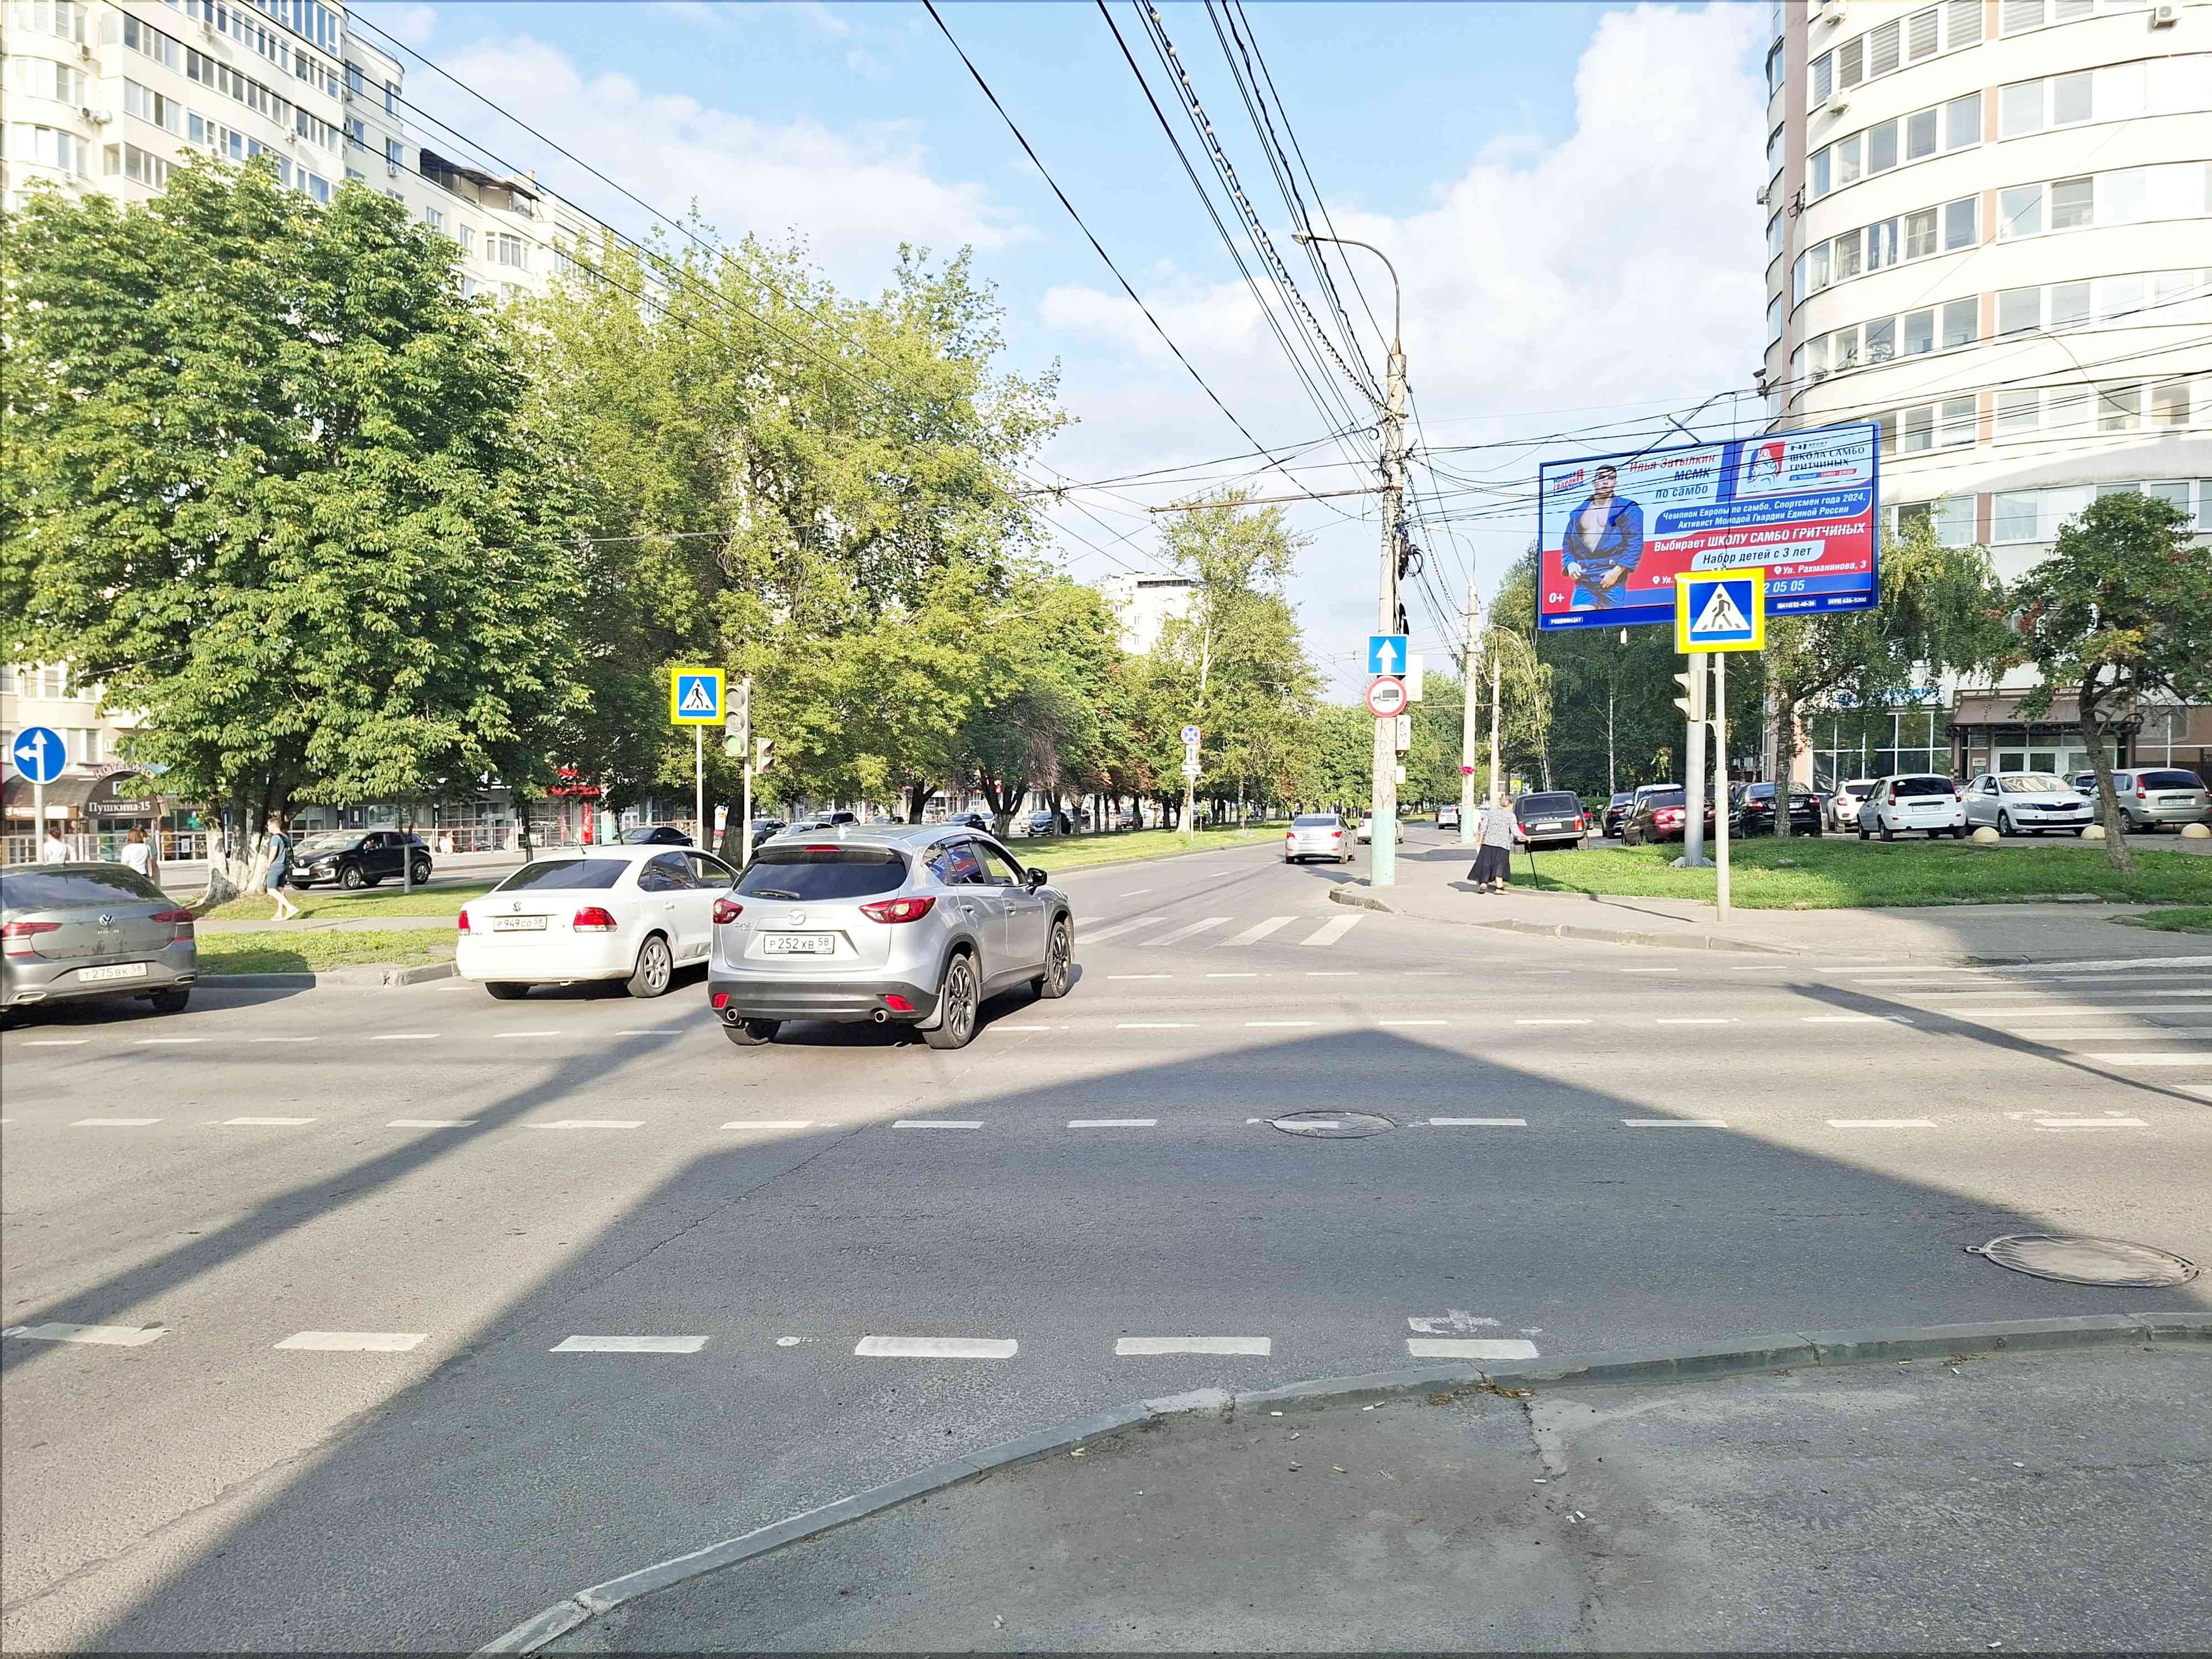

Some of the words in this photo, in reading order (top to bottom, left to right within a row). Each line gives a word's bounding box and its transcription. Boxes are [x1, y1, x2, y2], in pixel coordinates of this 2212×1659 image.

[1790, 451, 1826, 461] ШКОЛА
[1830, 446, 1865, 457] САМБО
[1629, 461, 1657, 472] Илья
[1790, 459, 1849, 471] ГРИТЧИНЫХ
[1656, 490, 1669, 499] по
[1672, 484, 1709, 497] самбо
[1664, 510, 1698, 520] Чемпион
[1699, 507, 1729, 517] Европы
[1743, 501, 1771, 513] самбо,
[1774, 498, 1820, 510] Спортсмен
[1821, 496, 1840, 505] года
[1843, 493, 1866, 503] 2024,
[1677, 519, 1713, 529] Активист
[1715, 514, 1751, 525] Молодой
[1752, 512, 1785, 523] Гвардии
[1787, 507, 1817, 519] Единой
[1819, 506, 1849, 515] России
[1654, 539, 1706, 552] Выбирает
[1707, 533, 1748, 547] ШКОЛУ
[1750, 529, 1790, 543] САМБО
[1792, 522, 1866, 540] ГРИТЧИНЫХ
[1703, 552, 1736, 565] Набор
[1739, 548, 1770, 563] детей
[1774, 550, 1779, 558] с
[1783, 547, 1789, 558] 3
[1793, 547, 1812, 557] лет
[1783, 566, 1795, 575] Ул.
[1798, 562, 1858, 574] Рахманинова,
[1860, 559, 1867, 569] 3
[1662, 575, 1673, 585] Ул.
[1772, 581, 1787, 593] 05
[1790, 579, 1805, 592] 05
[1549, 592, 1565, 604] 0+
[770, 938, 814, 949] Р252ХВ
[818, 938, 829, 946] 58
[84, 967, 128, 979] Т275ВК
[131, 964, 142, 972] 58
